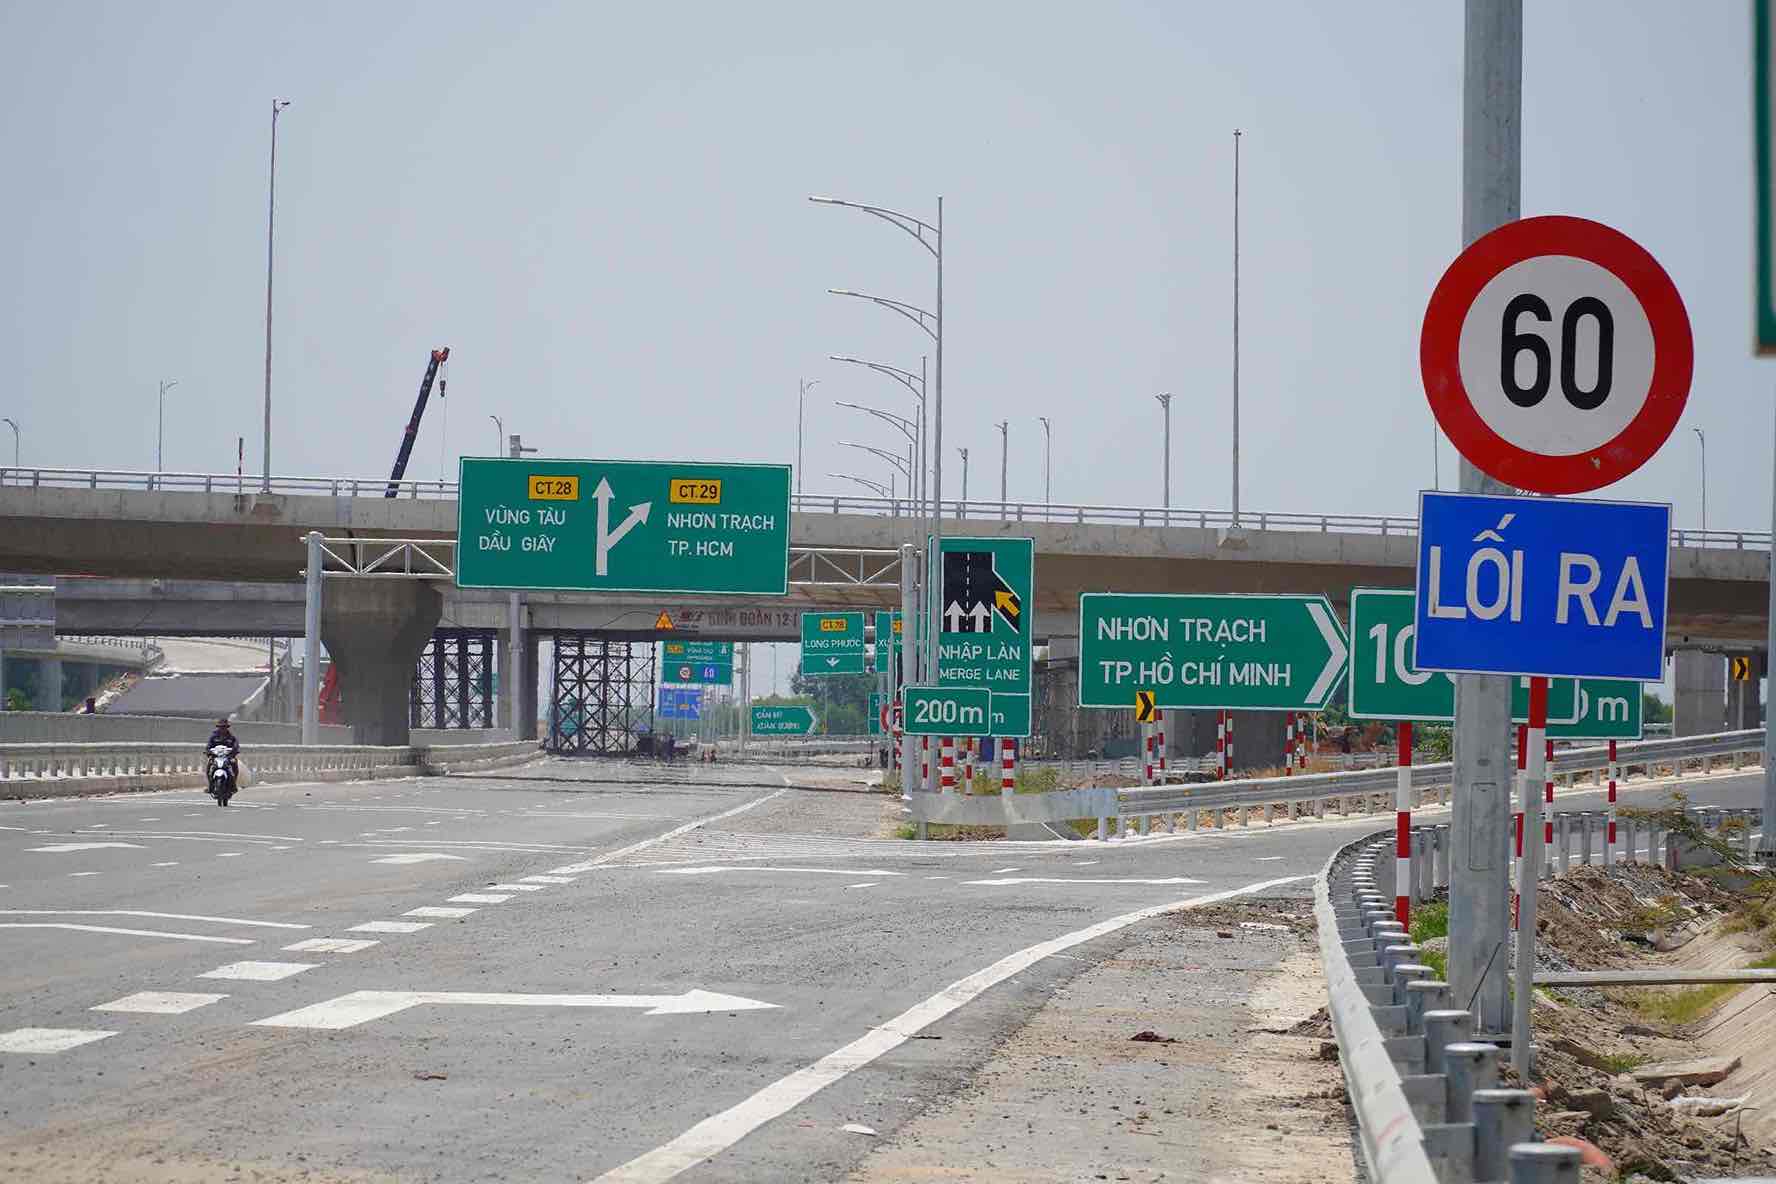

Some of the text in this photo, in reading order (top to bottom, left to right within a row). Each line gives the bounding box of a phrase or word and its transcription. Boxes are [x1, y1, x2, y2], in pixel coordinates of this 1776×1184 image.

[1500, 293, 1614, 410] 60
[535, 481, 572, 495] CT.28
[679, 485, 718, 499] CT.29
[485, 504, 566, 526] VŨNG TÀU
[667, 512, 775, 533] NHƠN TRẠCH
[479, 530, 556, 552] DẦU GIÂY
[1427, 513, 1654, 629] LỐI RA
[1097, 616, 1266, 648] NHƠN TRẠCH
[804, 639, 829, 648] LONG
[939, 641, 1021, 663] NHẬP LÀN
[939, 668, 1021, 681] MERGE LANE
[1181, 655, 1223, 686] CHÍ
[1229, 662, 1291, 687] MINH
